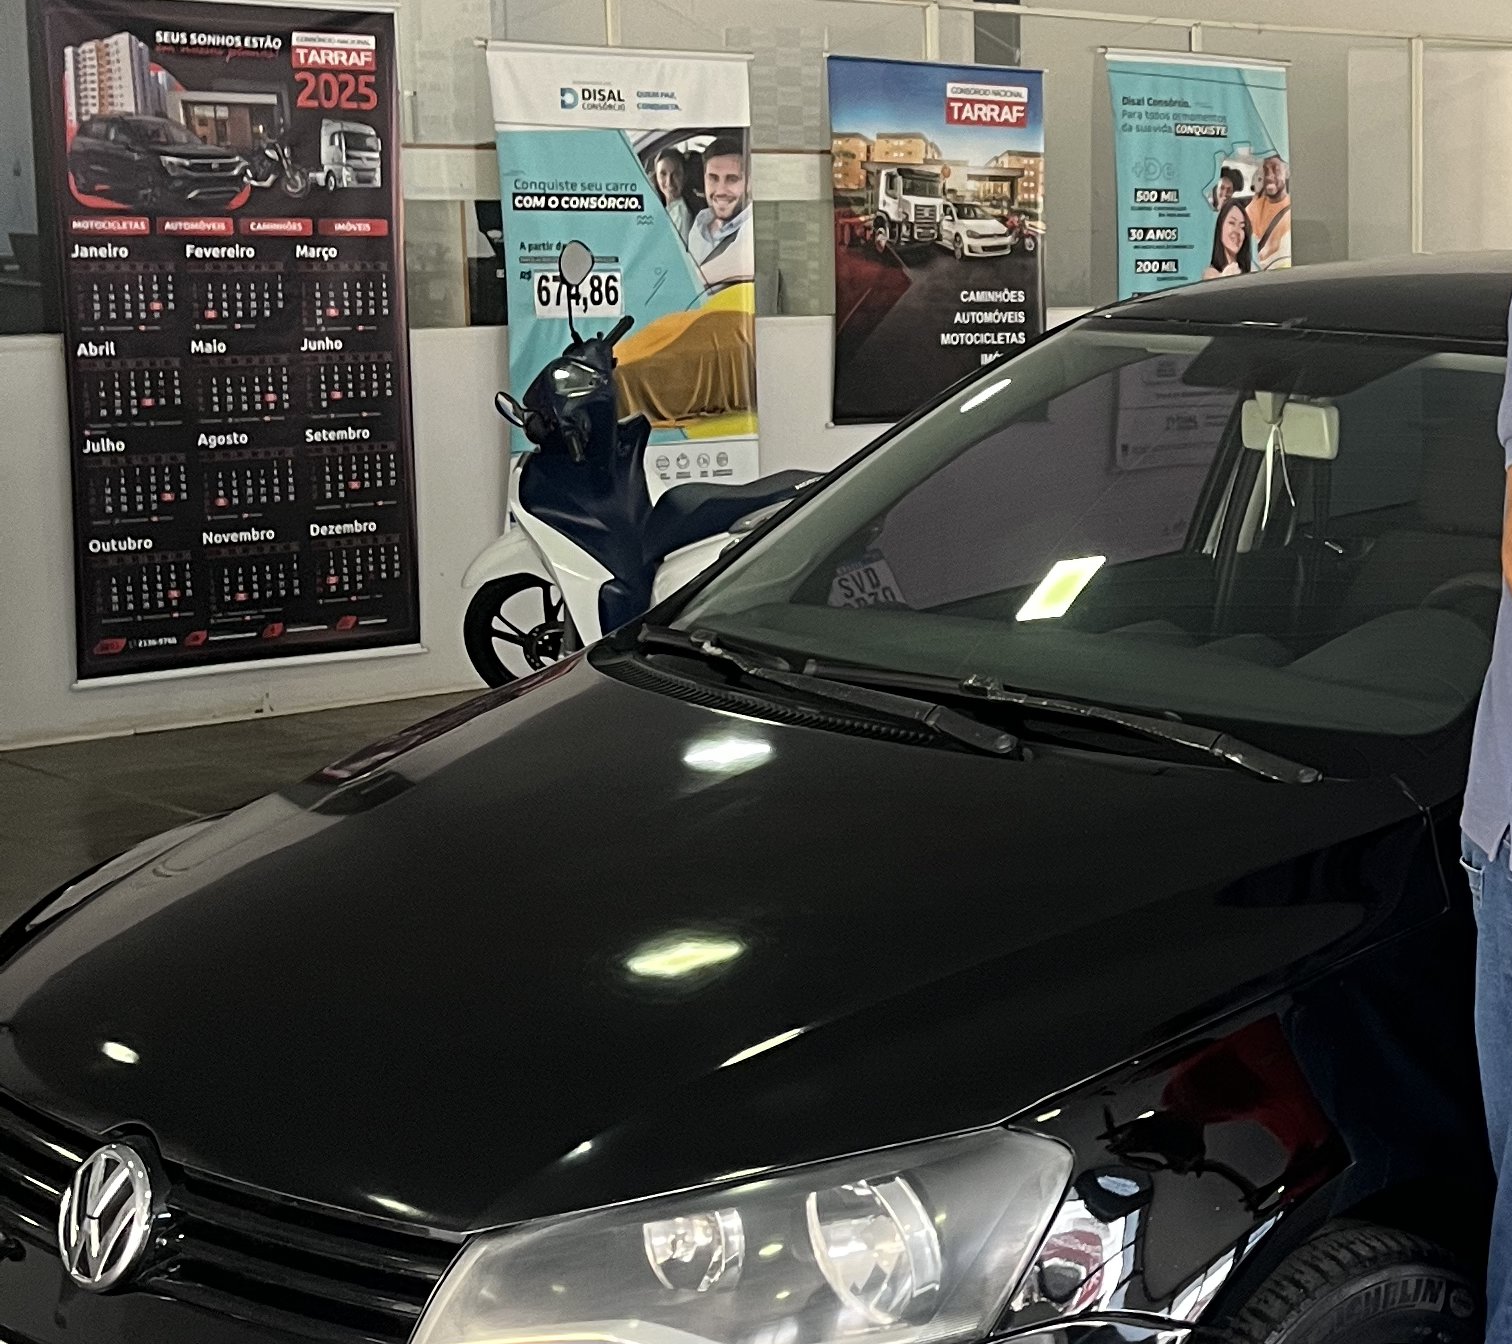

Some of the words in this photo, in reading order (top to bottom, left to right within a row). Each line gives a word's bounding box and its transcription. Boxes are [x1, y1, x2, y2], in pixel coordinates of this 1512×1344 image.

[155, 31, 187, 45] SEUS
[190, 33, 243, 47] SONHOS
[244, 34, 282, 50] ESTÃO
[295, 48, 373, 66] TARRAF
[295, 71, 378, 110] 2025
[582, 88, 625, 102] DISAL
[950, 102, 1025, 123] TARRAF
[1175, 124, 1228, 136] CONQUISTE
[514, 178, 578, 193] Conquiste
[580, 182, 603, 192] seu
[605, 183, 638, 192] carro
[514, 195, 546, 209] COM
[547, 196, 560, 209] O
[560, 193, 642, 210] CONSÓRCIO.
[1135, 190, 1159, 202] 500
[1160, 190, 1179, 202] MIL
[72, 220, 147, 231] MOTOCICLETAS
[164, 220, 226, 231] AUTOMÓVEIS
[1128, 229, 1144, 241] 30
[1145, 229, 1177, 241] ANOS
[71, 242, 129, 259] Janeiro
[186, 243, 256, 259] Fevereiro
[295, 244, 338, 262] Março
[520, 241, 527, 251] A
[528, 242, 554, 253] partir
[1136, 260, 1160, 273] 200
[1161, 261, 1178, 273] MIL
[954, 308, 1026, 324] AUTOMÓVEIS
[190, 338, 227, 354] Maio
[300, 336, 343, 352] Junho
[940, 331, 1026, 345] MOTOCICLETAS
[77, 340, 116, 357] Abril
[197, 431, 249, 449] Agosto
[305, 426, 370, 443] Setembro
[83, 438, 126, 454] Julho
[202, 527, 276, 545] Novembro
[309, 519, 377, 537] Dezembro
[88, 536, 153, 554] Outubro
